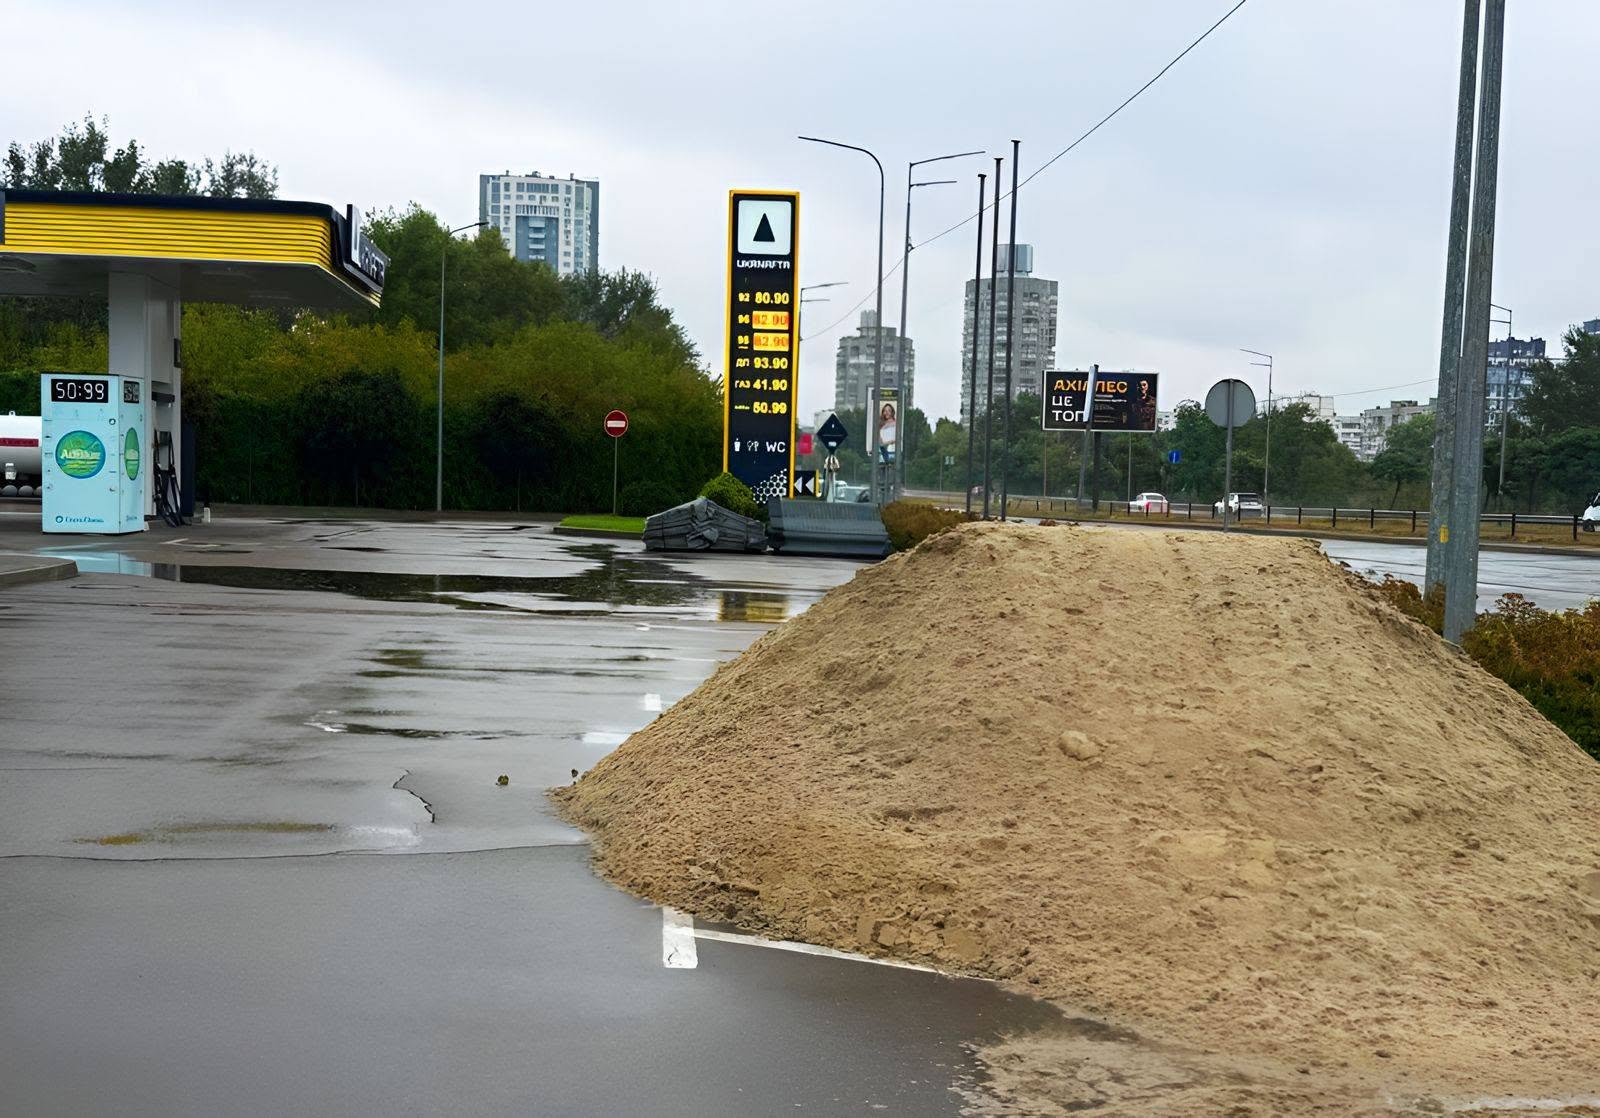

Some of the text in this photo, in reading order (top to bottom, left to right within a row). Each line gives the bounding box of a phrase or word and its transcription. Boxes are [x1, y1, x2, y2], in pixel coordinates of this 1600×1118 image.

[753, 357, 788, 370] 93.90
[753, 378, 788, 391] 41.90
[752, 401, 788, 414] 50.99
[765, 441, 786, 453] WC
